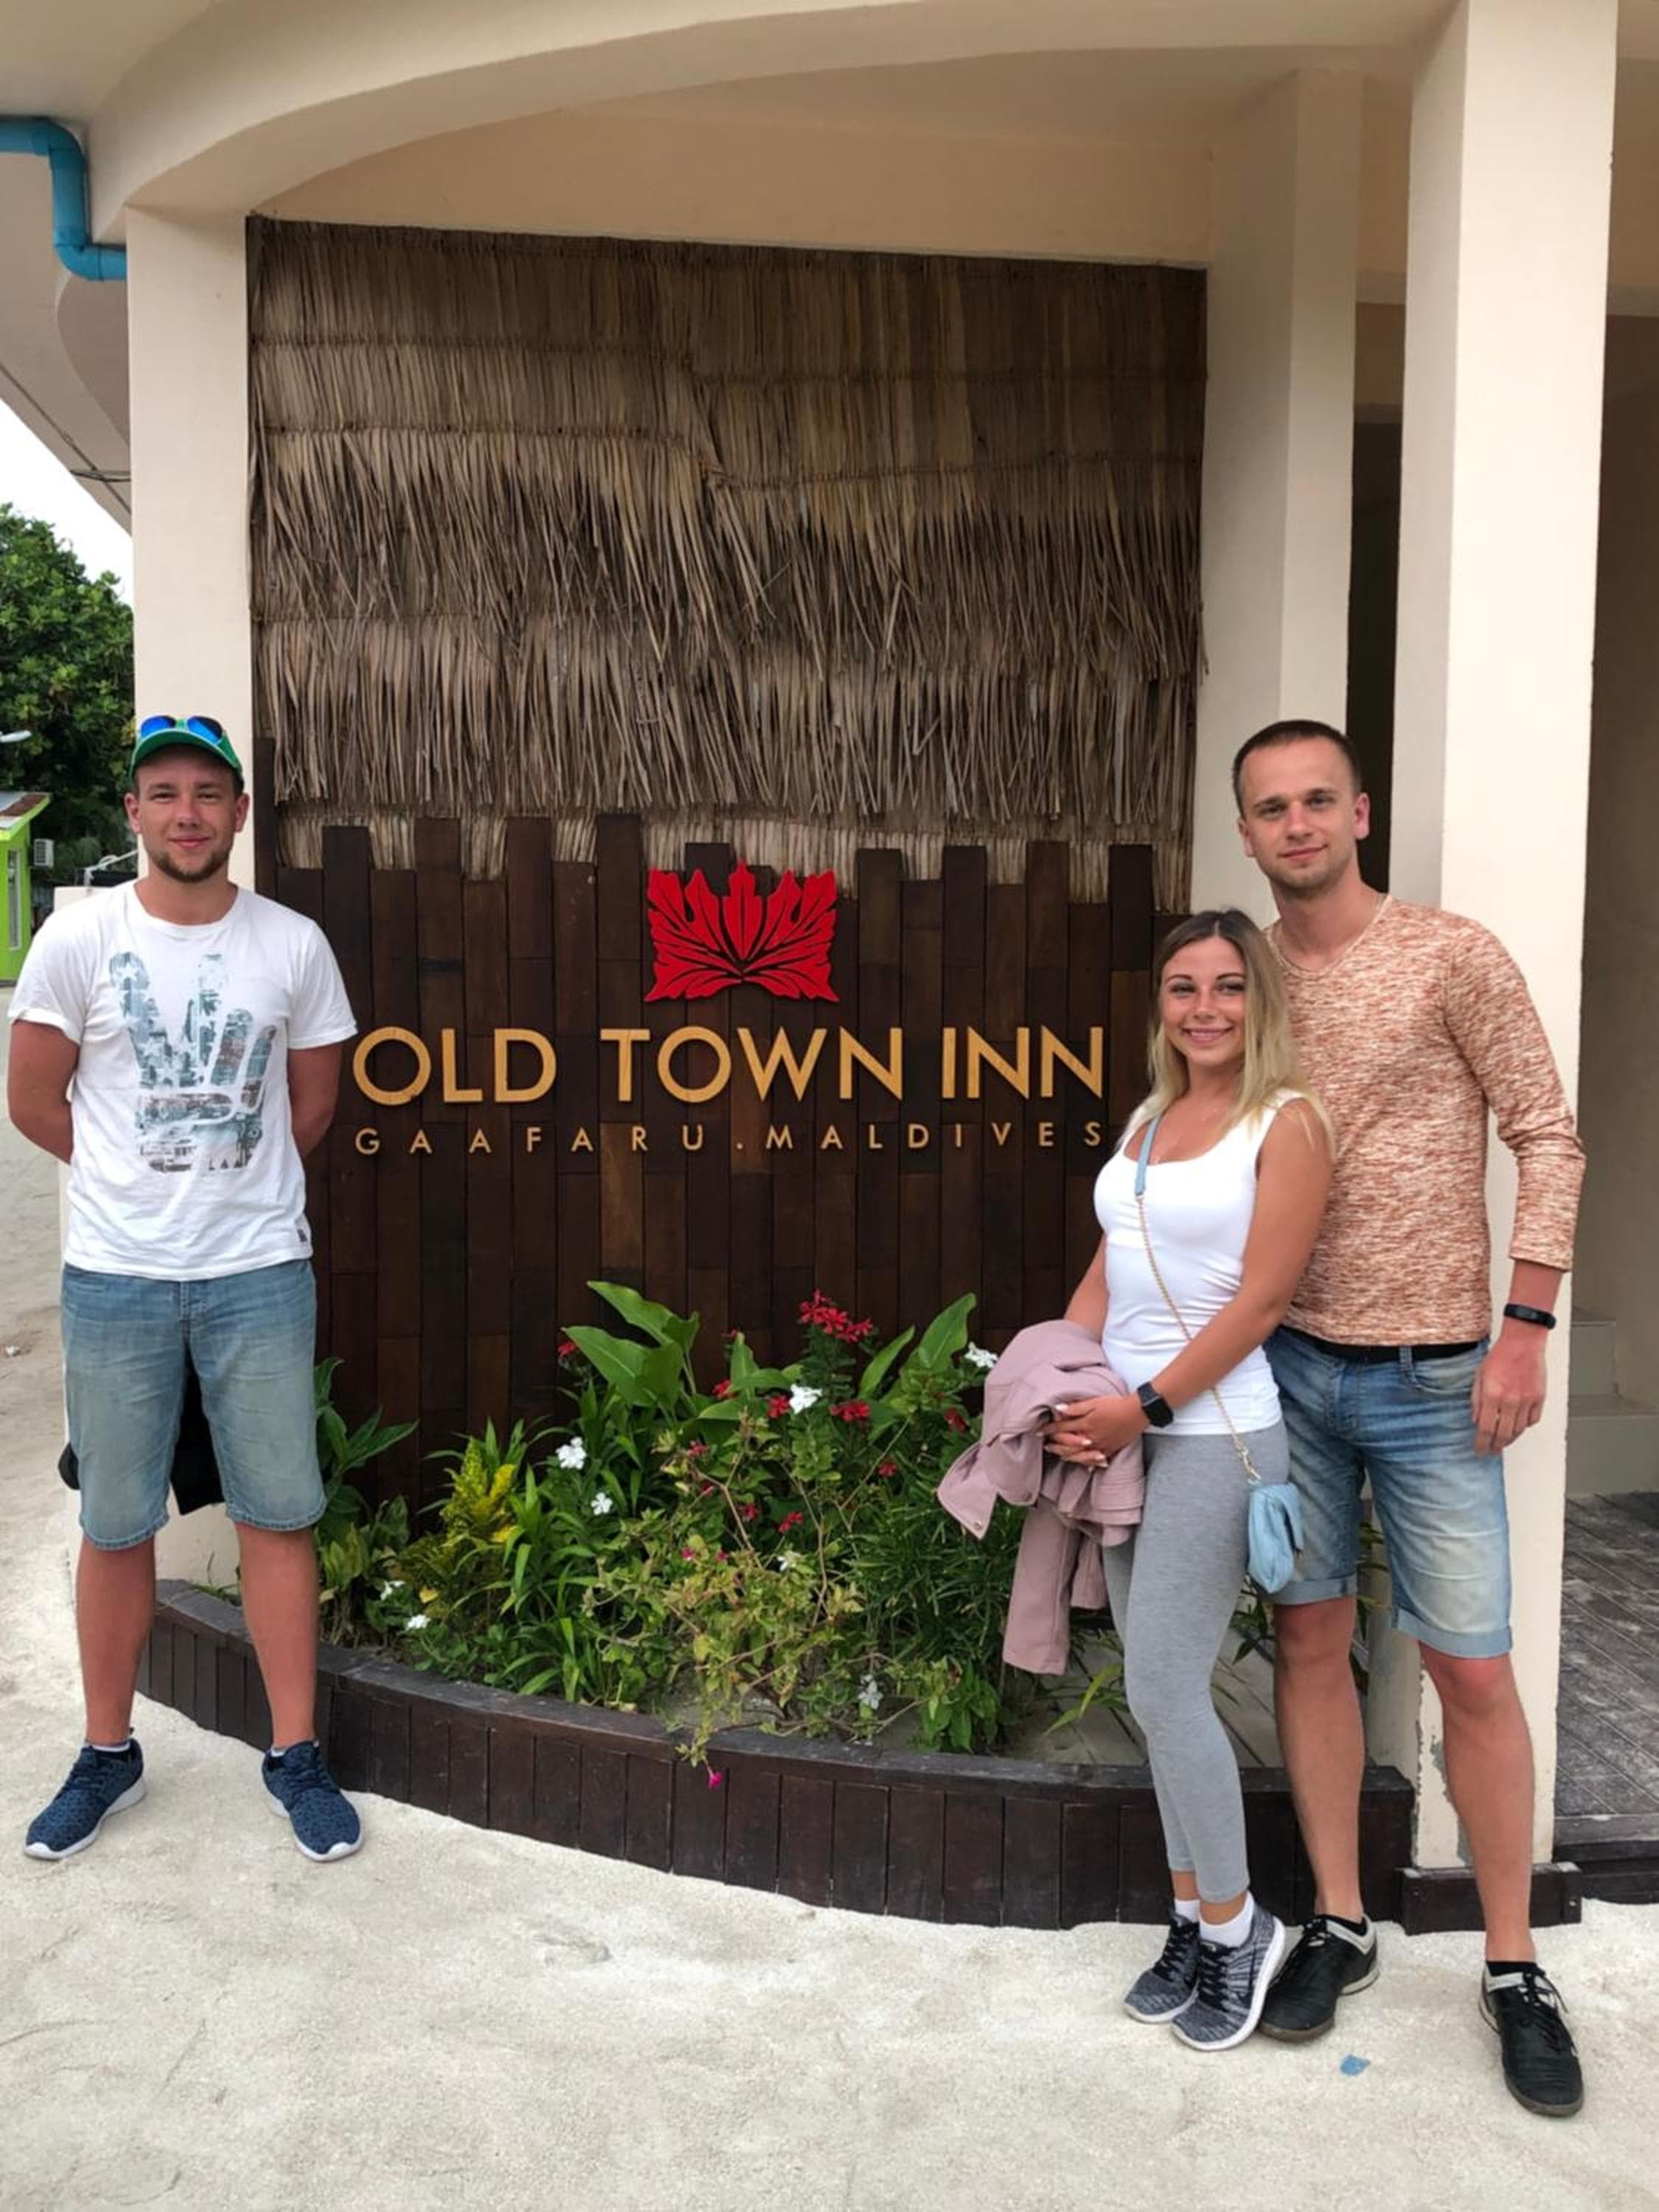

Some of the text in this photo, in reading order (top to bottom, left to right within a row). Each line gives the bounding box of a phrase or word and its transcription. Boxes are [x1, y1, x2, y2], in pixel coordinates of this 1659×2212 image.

[352, 1026, 1103, 1105] OLD TOWN INN
